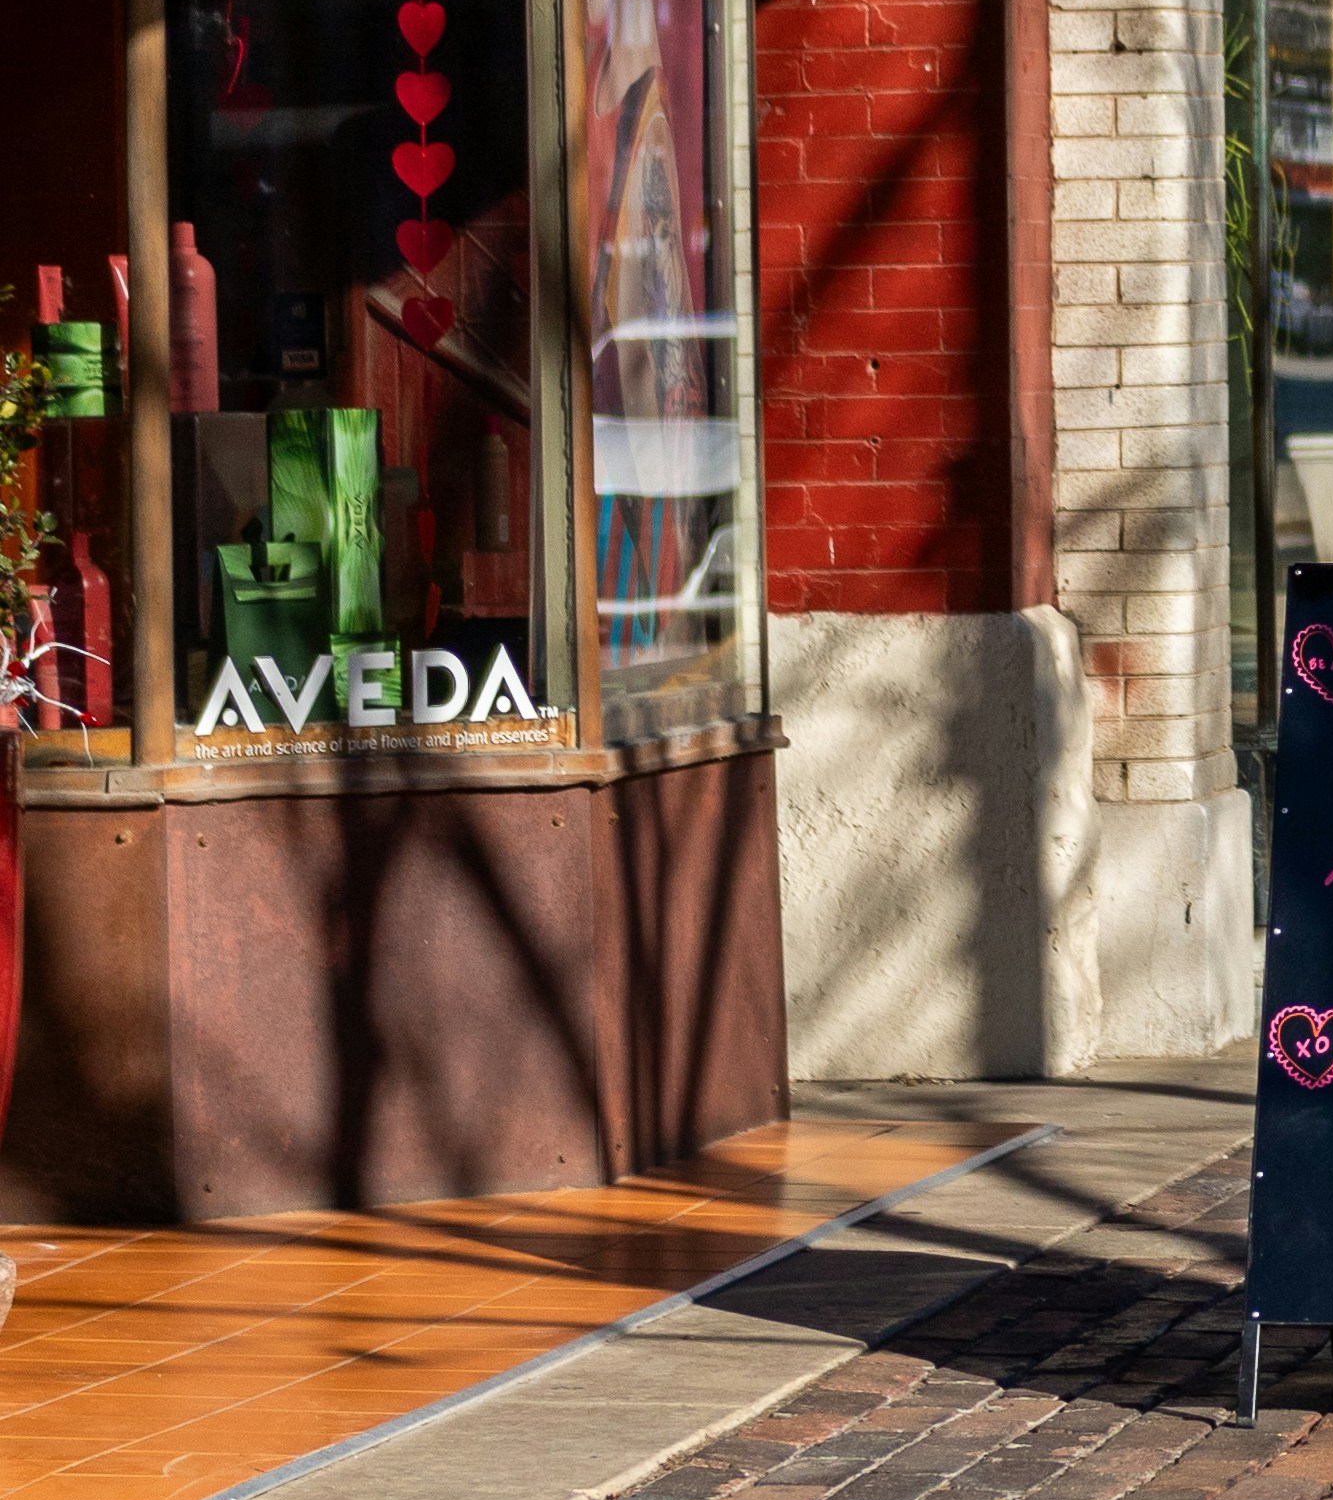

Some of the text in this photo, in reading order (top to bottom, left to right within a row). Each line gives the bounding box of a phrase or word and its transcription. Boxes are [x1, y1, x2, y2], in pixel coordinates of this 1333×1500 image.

[1308, 656, 1326, 671] BE
[193, 642, 540, 737] AVEDA
[195, 743, 219, 760] the
[221, 742, 242, 759] art
[244, 740, 273, 757] and
[275, 739, 328, 756] science
[329, 737, 344, 753] of
[346, 738, 378, 754] pure
[381, 733, 422, 750] flower
[425, 732, 452, 748] and
[455, 728, 489, 749] plant
